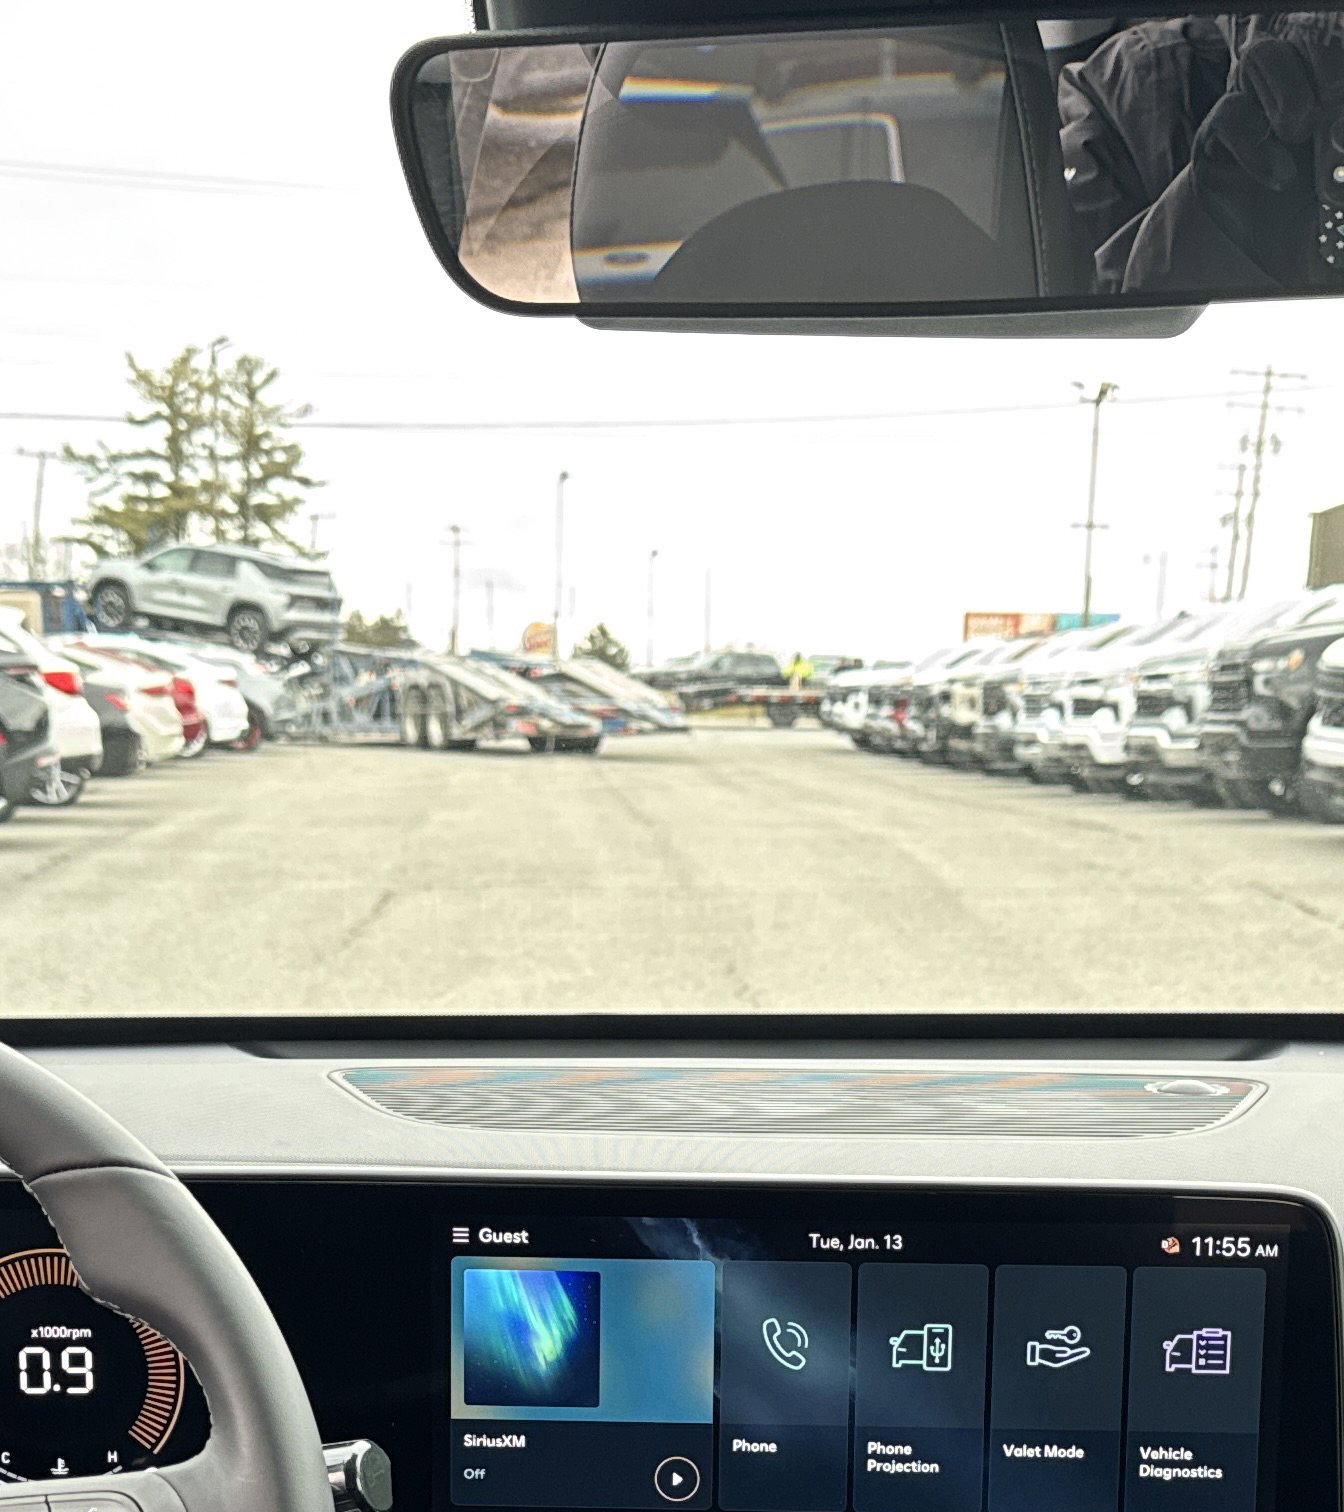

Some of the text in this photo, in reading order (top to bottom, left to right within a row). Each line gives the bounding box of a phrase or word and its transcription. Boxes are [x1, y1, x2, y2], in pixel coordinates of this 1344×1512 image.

[479, 1228, 528, 1243] Guest
[809, 1234, 902, 1251] Tue, Jan. 13
[1192, 1237, 1278, 1257] 11:55 AM
[31, 1327, 91, 1340] x1000rpm
[19, 1347, 93, 1394] 0.9
[464, 1434, 525, 1447] SiriusXM
[733, 1439, 777, 1452] Phone
[868, 1442, 912, 1455] Phone
[1003, 1444, 1084, 1458] Valet Mode
[1140, 1447, 1192, 1460] Vehicle
[2, 1452, 10, 1463] C
[108, 1451, 117, 1462] H
[868, 1459, 939, 1473] Projection
[1140, 1465, 1222, 1480] Diagnostics
[464, 1469, 485, 1479] Off
